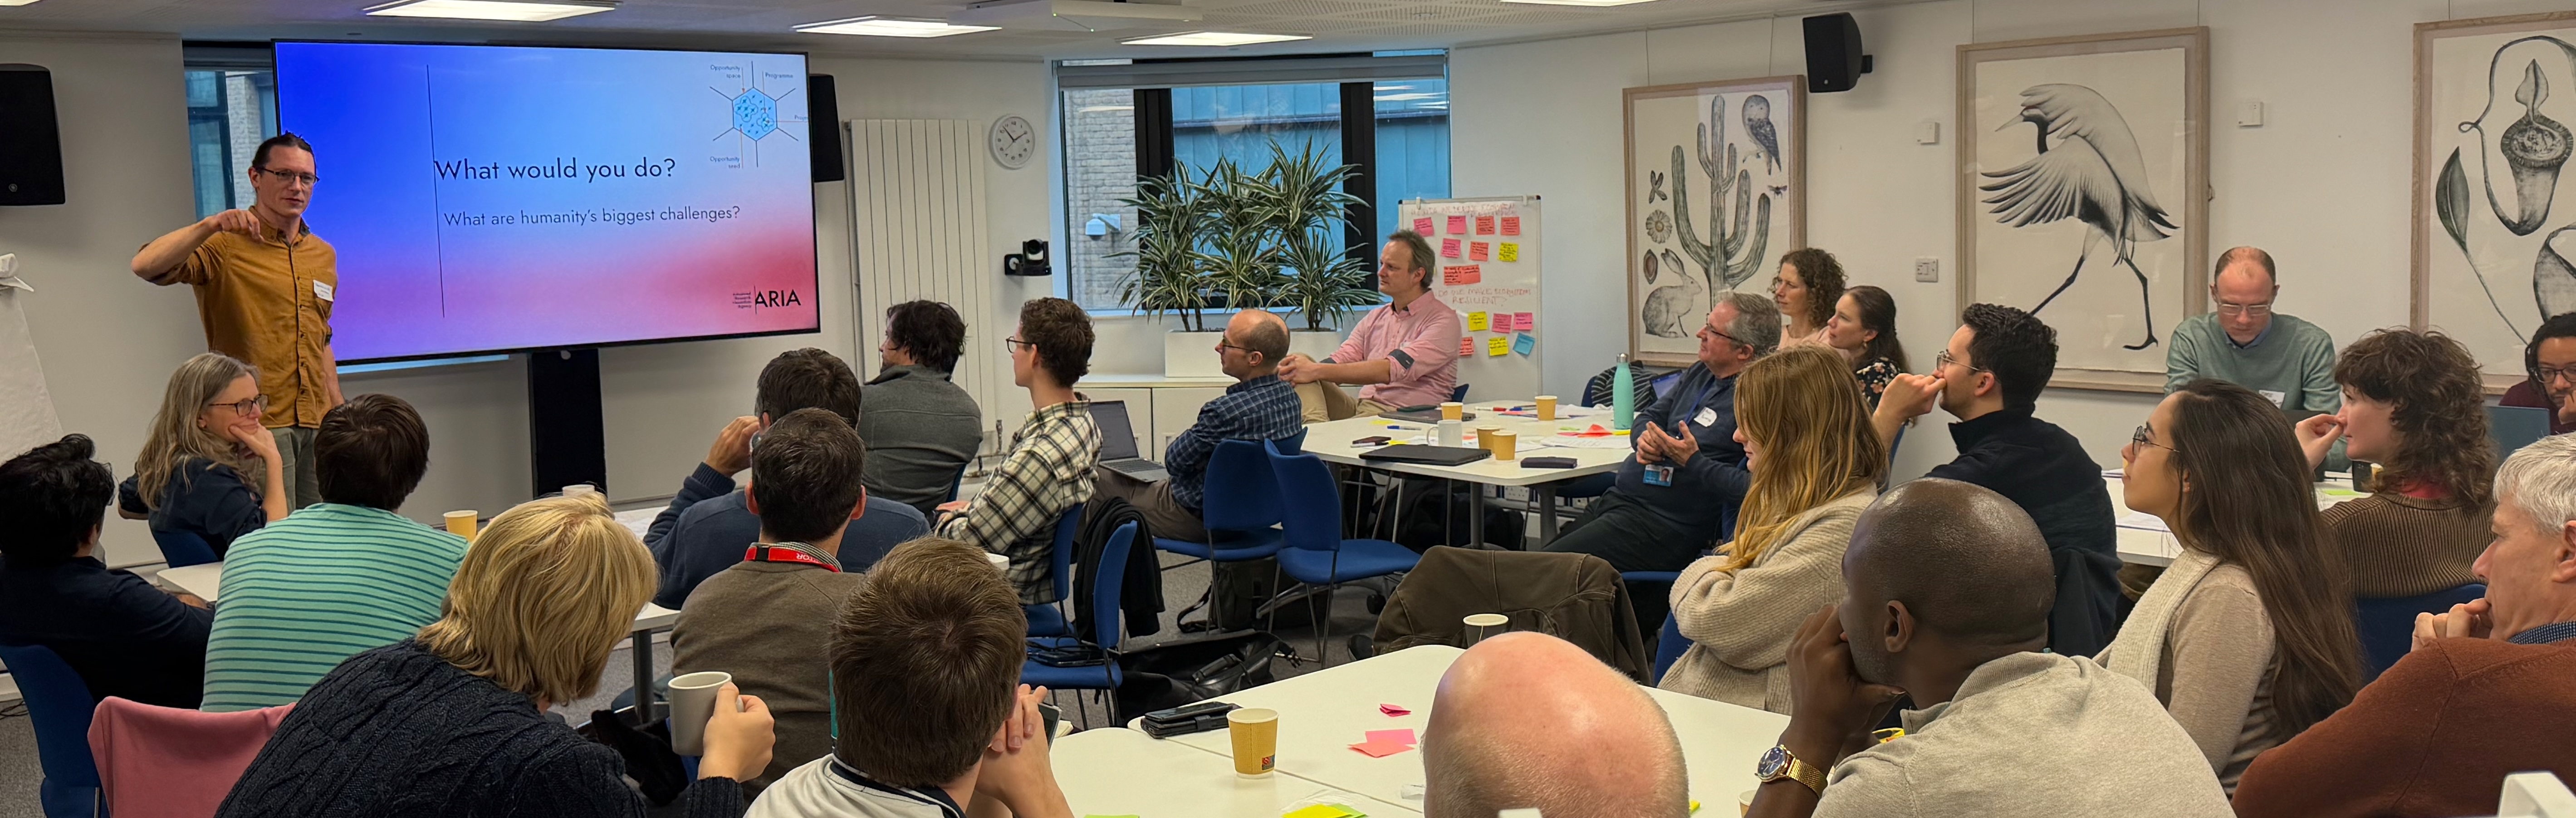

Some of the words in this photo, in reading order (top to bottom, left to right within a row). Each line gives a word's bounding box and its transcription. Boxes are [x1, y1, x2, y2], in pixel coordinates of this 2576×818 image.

[434, 158, 499, 180] What
[507, 157, 577, 179] would
[586, 165, 625, 183] you
[635, 157, 676, 177] do?
[444, 212, 485, 226] What
[491, 215, 514, 225] are
[521, 209, 597, 226] humanity's
[602, 207, 655, 225] biggest
[660, 205, 740, 222] challenges?
[755, 289, 802, 307] ARIA
